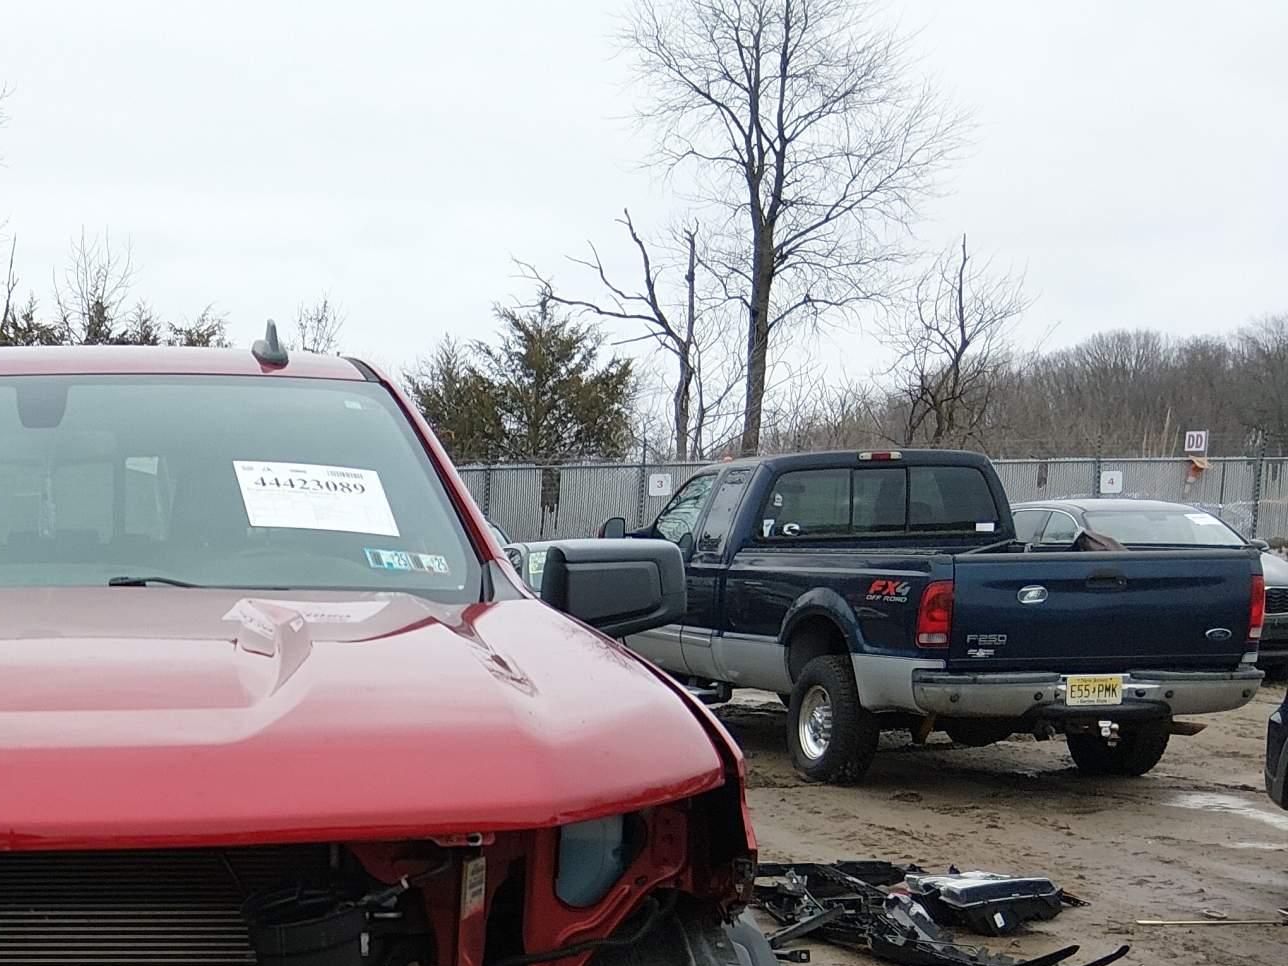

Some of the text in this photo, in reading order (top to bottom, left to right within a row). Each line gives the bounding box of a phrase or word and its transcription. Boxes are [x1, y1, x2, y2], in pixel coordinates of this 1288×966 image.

[1187, 433, 1204, 449] DD
[254, 476, 366, 495] 44423089
[656, 480, 664, 489] 3
[1107, 478, 1114, 486] 4
[869, 580, 911, 596] FX4
[883, 595, 908, 603] ROAD
